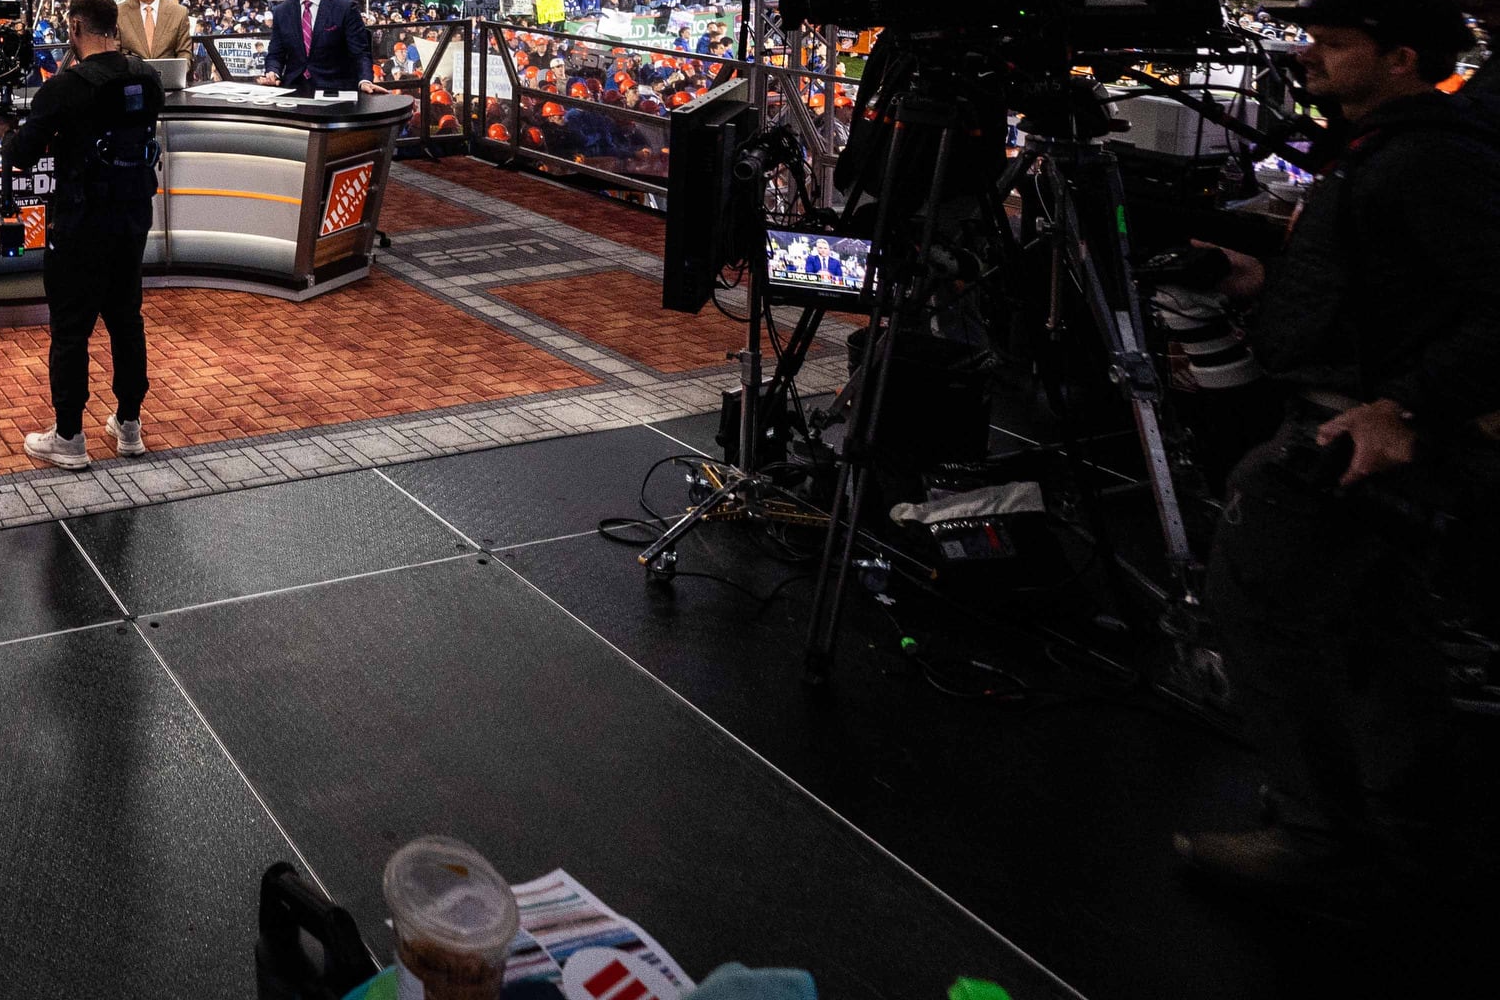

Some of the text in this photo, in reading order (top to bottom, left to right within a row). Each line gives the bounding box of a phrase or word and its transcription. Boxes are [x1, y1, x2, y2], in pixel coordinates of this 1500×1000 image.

[219, 41, 252, 49] RUDY WAS
[219, 49, 252, 57] BAPTIZED
[325, 169, 373, 232] HOME
[411, 238, 560, 266] ESPN
